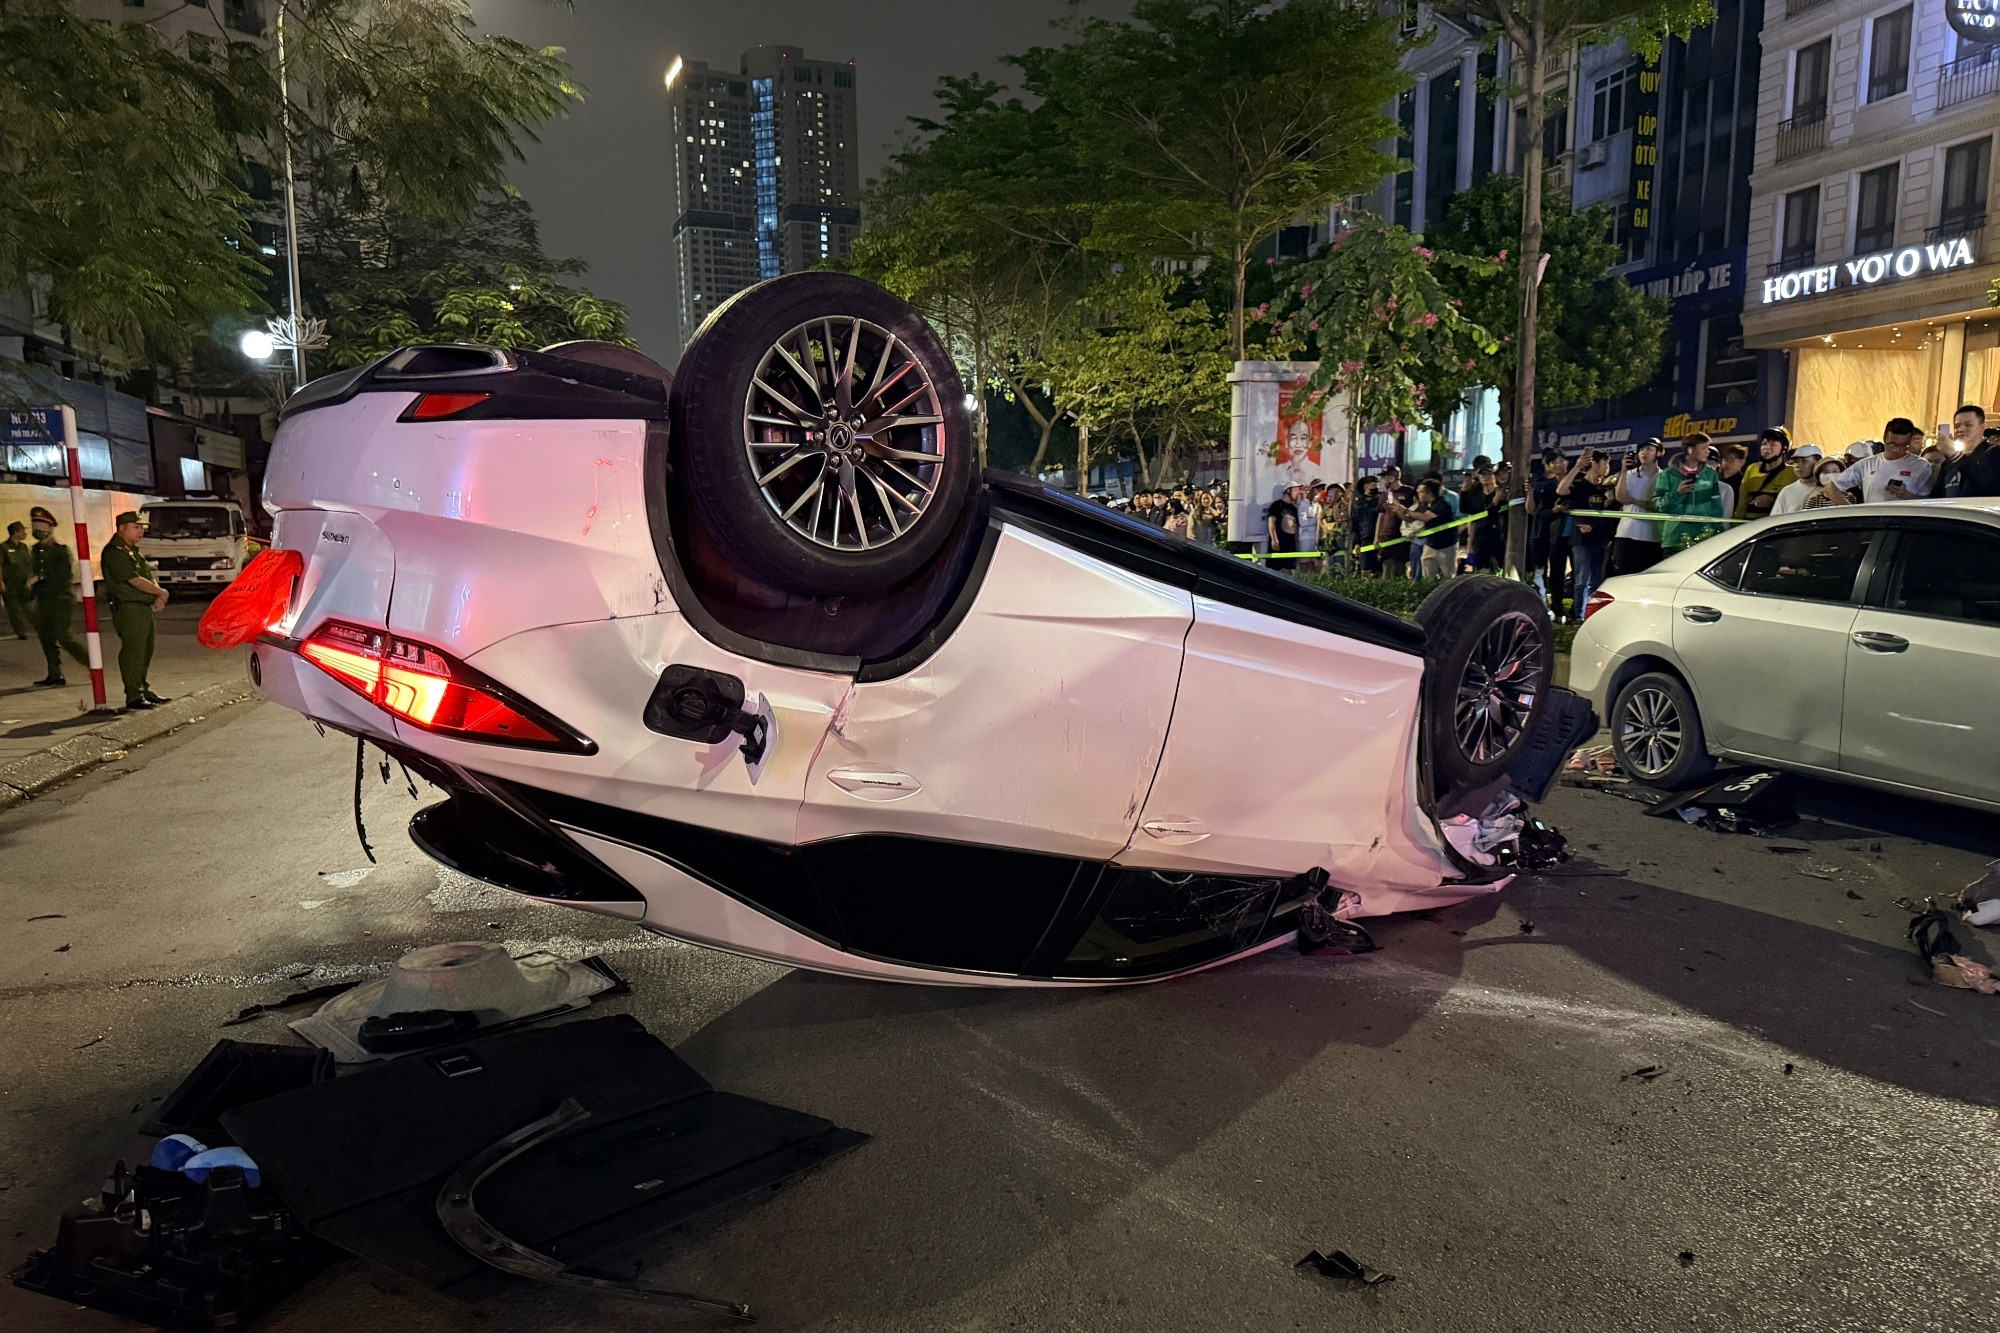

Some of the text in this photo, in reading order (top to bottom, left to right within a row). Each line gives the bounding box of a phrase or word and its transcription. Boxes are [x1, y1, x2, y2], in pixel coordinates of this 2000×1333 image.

[1636, 180, 1650, 200] XE
[1633, 207, 1649, 228] GA
[1925, 238, 1975, 271] WA
[1672, 261, 1705, 298] LỐP
[1707, 263, 1732, 290] XE
[1559, 428, 1632, 448] MICHELIN
